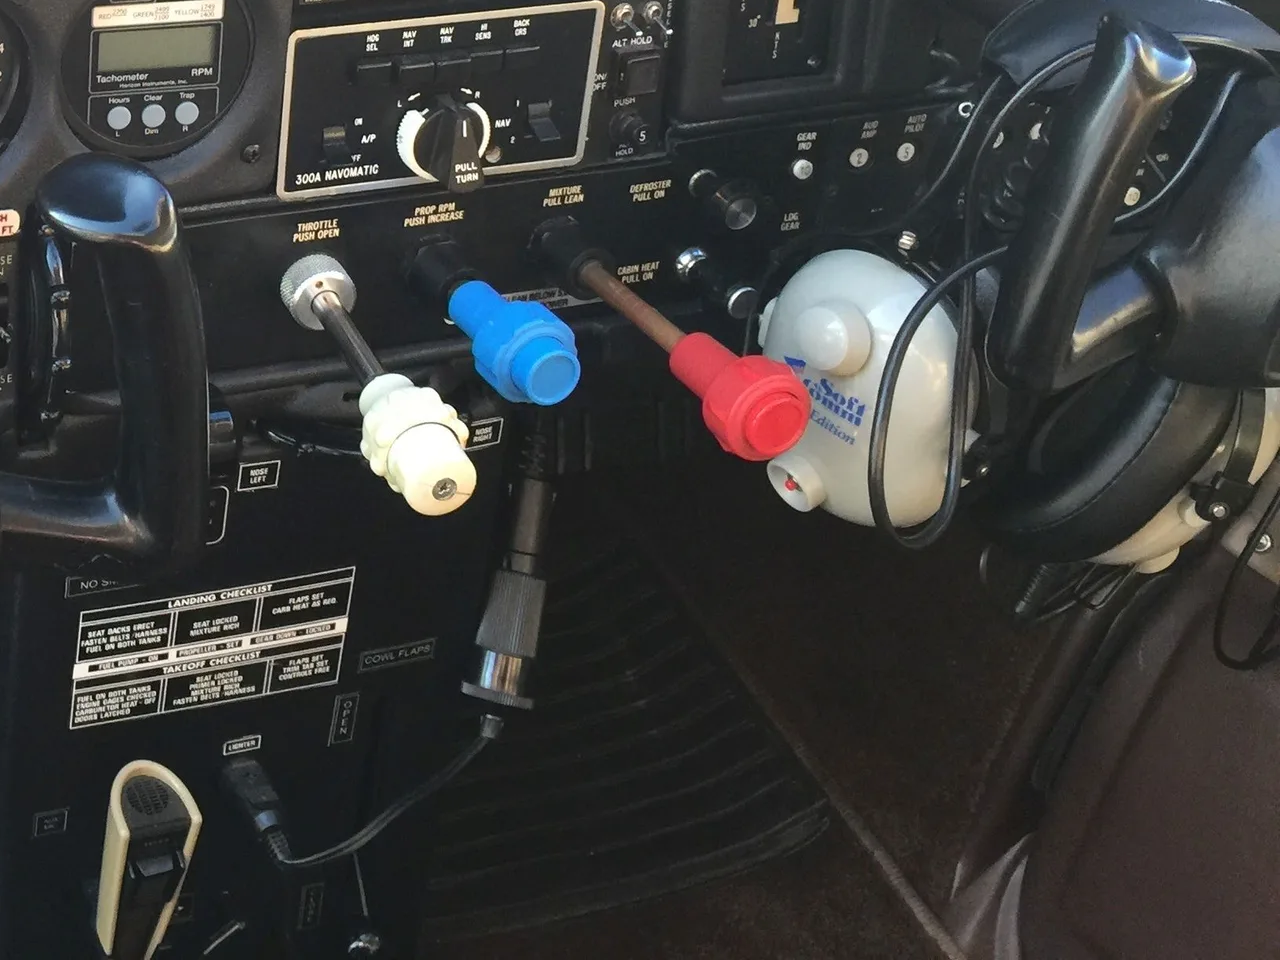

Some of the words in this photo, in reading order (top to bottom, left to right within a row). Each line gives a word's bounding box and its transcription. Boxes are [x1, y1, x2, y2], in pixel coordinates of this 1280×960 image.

[612, 38, 628, 48] ALT
[631, 36, 652, 45] HOLD
[192, 68, 213, 77] RPM
[96, 73, 148, 84] Tachometer
[109, 96, 130, 104] Hours
[144, 94, 163, 102] Clear
[180, 92, 195, 100] Trap
[797, 132, 816, 141] GEAR
[798, 141, 812, 151] IND
[455, 163, 477, 171] PULL
[296, 174, 321, 185] 300A
[325, 164, 379, 181] NAVOMATIC
[456, 173, 478, 183] TURN
[549, 185, 582, 196] MIXTURE
[630, 179, 671, 193] DEFROSTER
[543, 197, 562, 207] PULL
[564, 194, 584, 204] LEAN
[415, 205, 435, 216] PROP
[438, 203, 455, 213] RPM
[404, 216, 425, 227] PUSH
[427, 210, 464, 223] INCREASE
[298, 218, 338, 232] THROTTLE
[293, 230, 315, 242] PUSH
[317, 228, 339, 238] OPEN
[617, 266, 638, 275] CABIN
[641, 261, 660, 272] HEAT
[168, 594, 216, 608] LANDING
[220, 584, 272, 599] CHECKLIST
